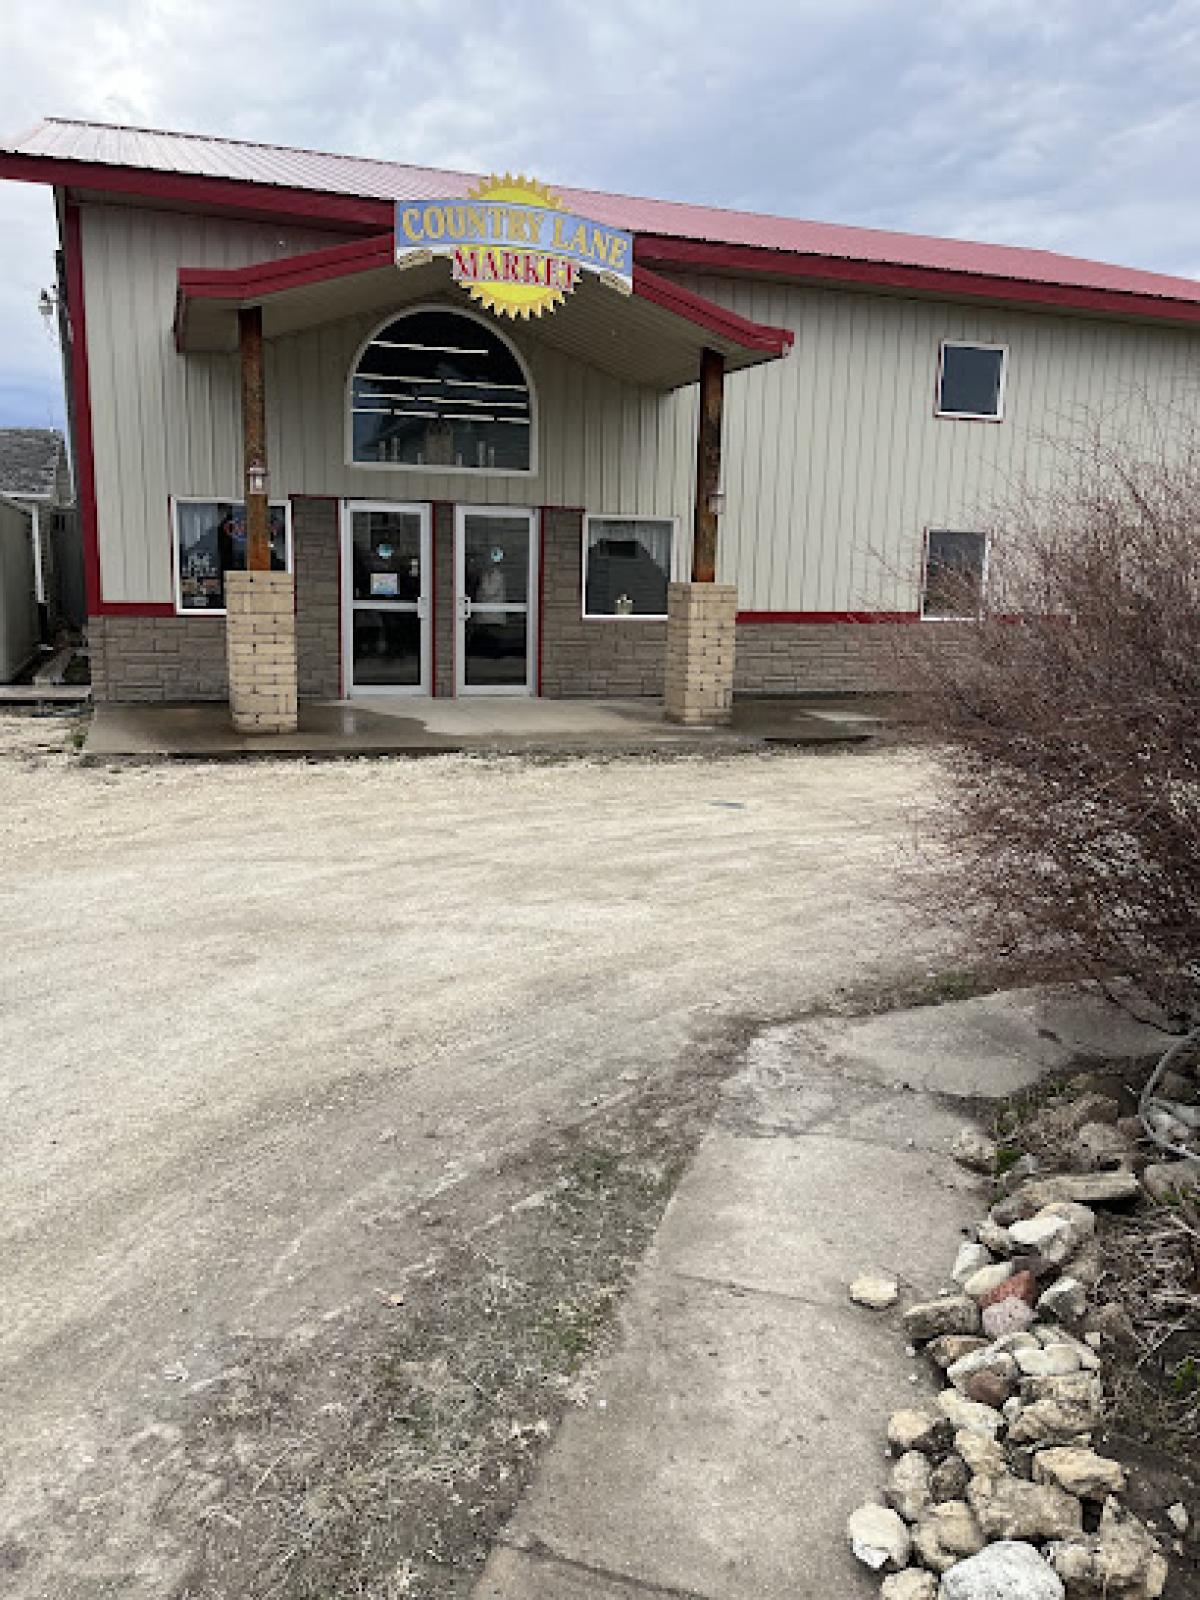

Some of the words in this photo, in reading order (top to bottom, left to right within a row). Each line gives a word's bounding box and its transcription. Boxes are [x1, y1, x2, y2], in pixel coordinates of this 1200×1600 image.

[402, 205, 544, 243] COUNTRY
[552, 217, 628, 268] LANE
[454, 249, 576, 289] MARKET
